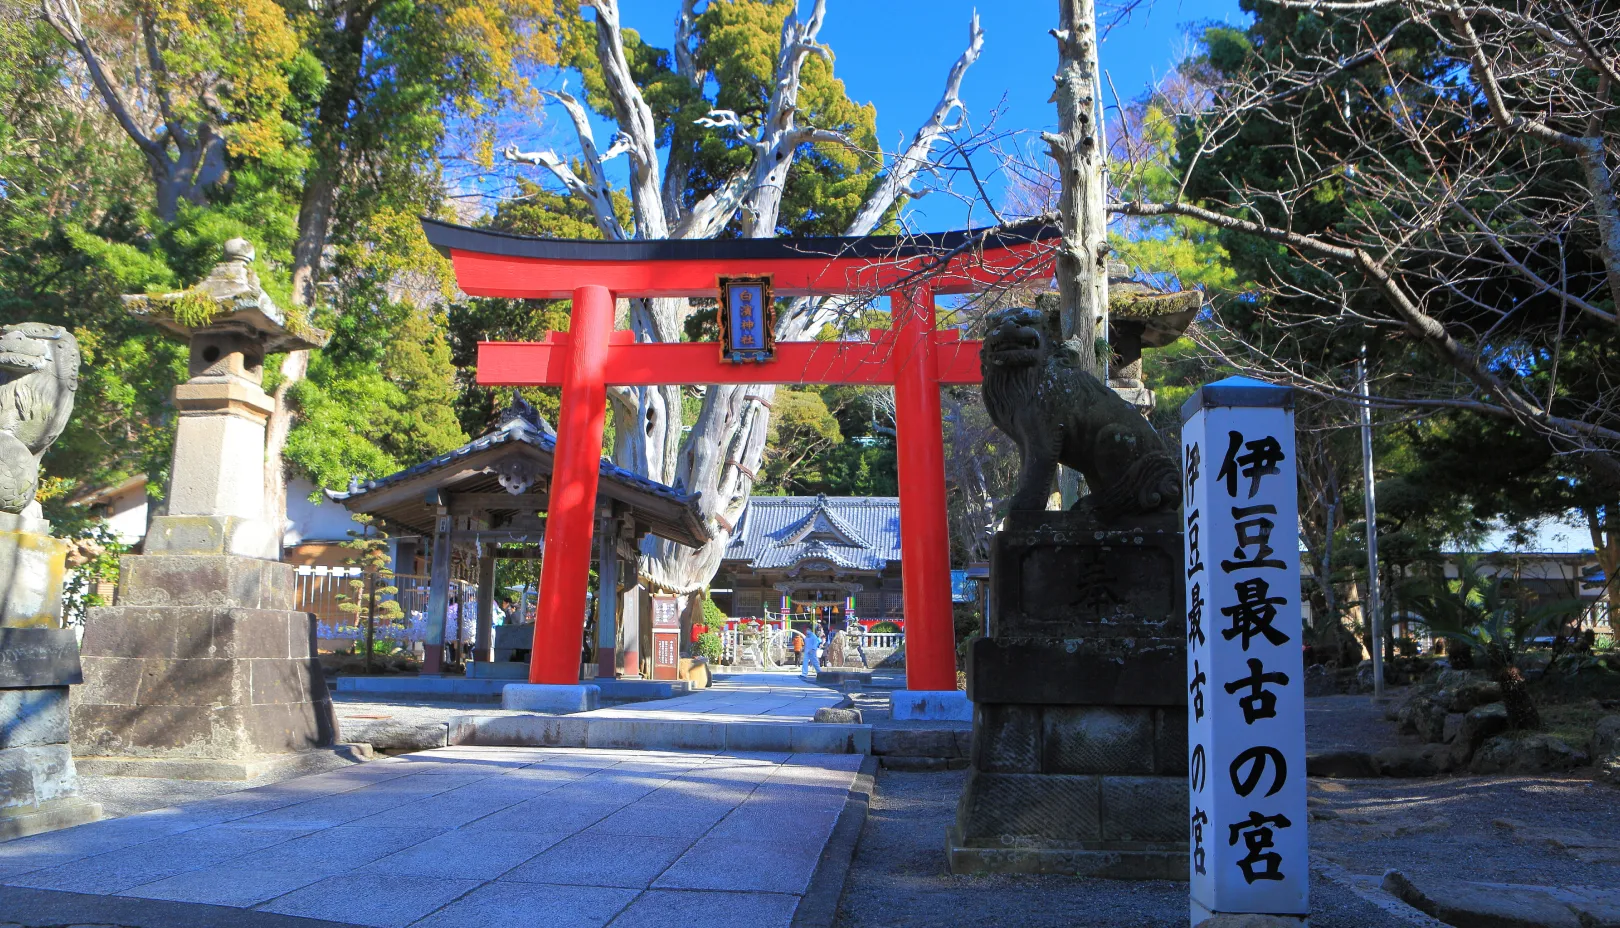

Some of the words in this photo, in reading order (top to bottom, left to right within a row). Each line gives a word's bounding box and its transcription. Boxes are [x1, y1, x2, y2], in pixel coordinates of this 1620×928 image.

[1184, 440, 1207, 877] 伊豆最古の宮
[1216, 430, 1291, 884] 伊豆最古の宮
